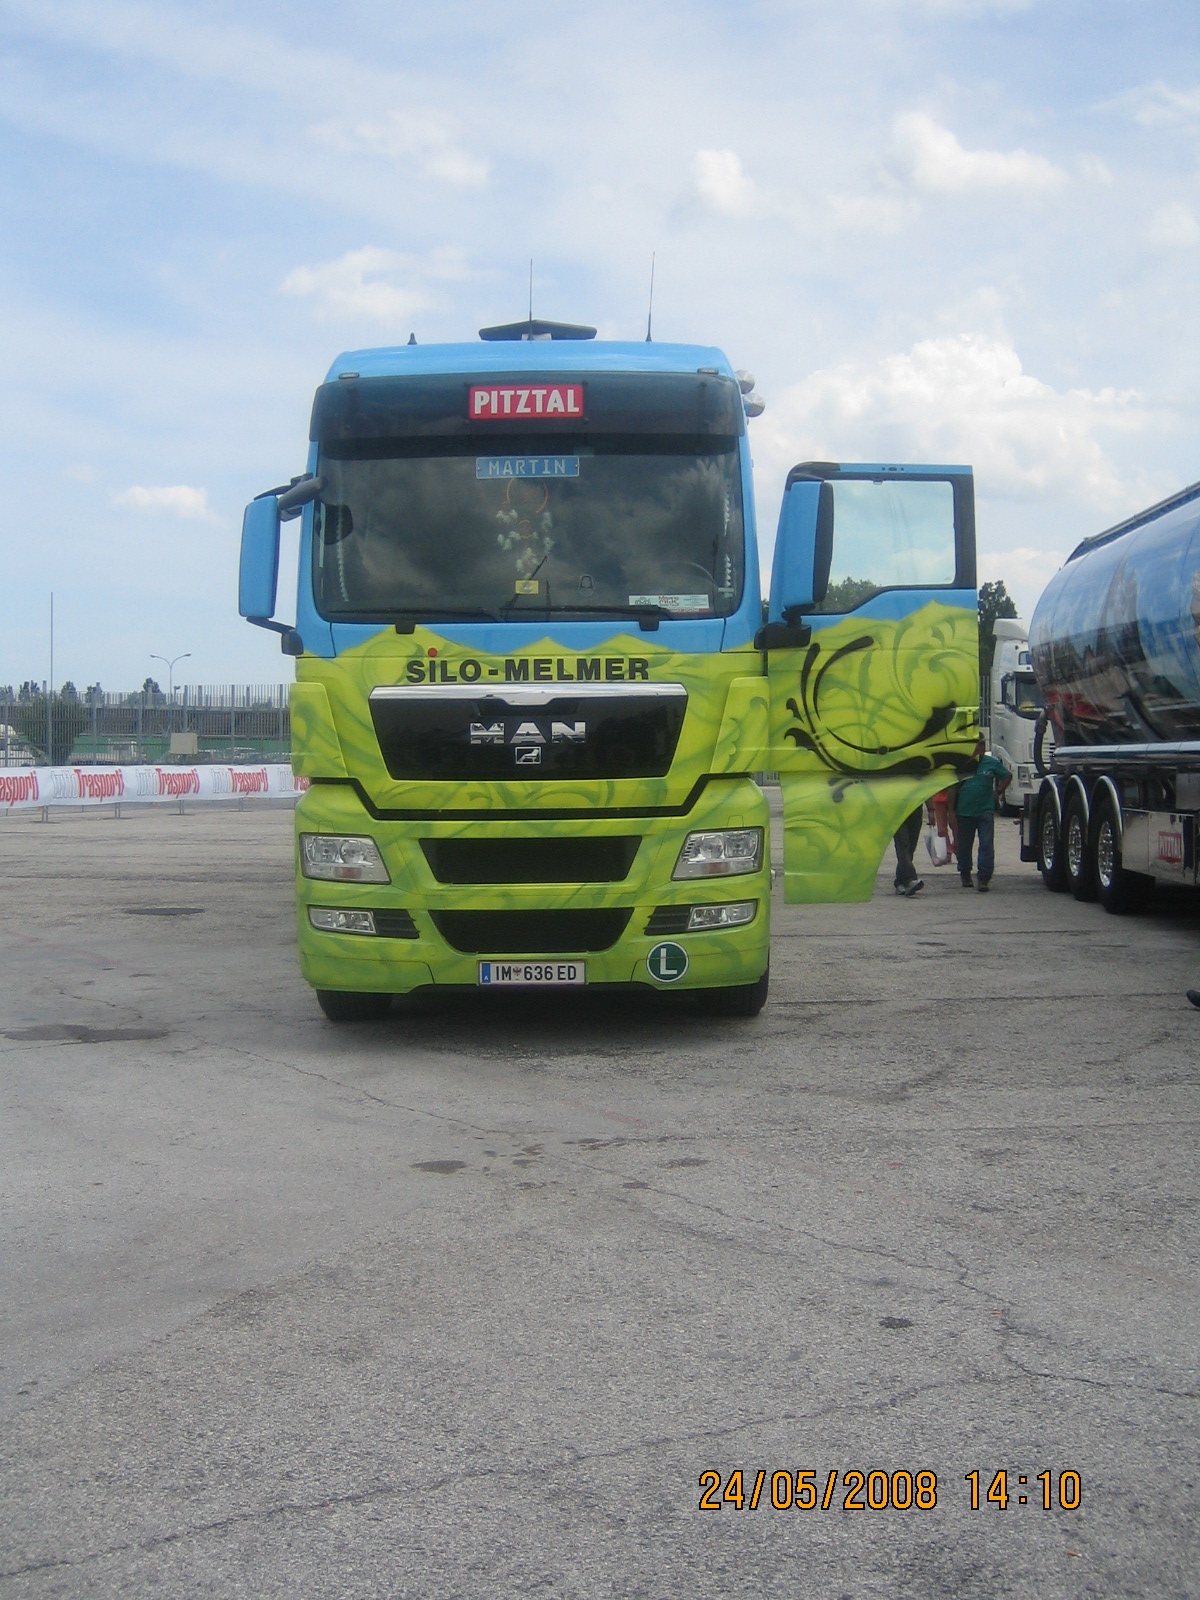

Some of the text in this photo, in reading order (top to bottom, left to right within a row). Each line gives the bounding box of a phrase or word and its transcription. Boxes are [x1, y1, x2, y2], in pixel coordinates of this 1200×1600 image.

[474, 389, 580, 414] PITZTAL
[488, 459, 566, 475] MARTIN
[470, 722, 586, 744] MAN
[659, 948, 678, 975] L
